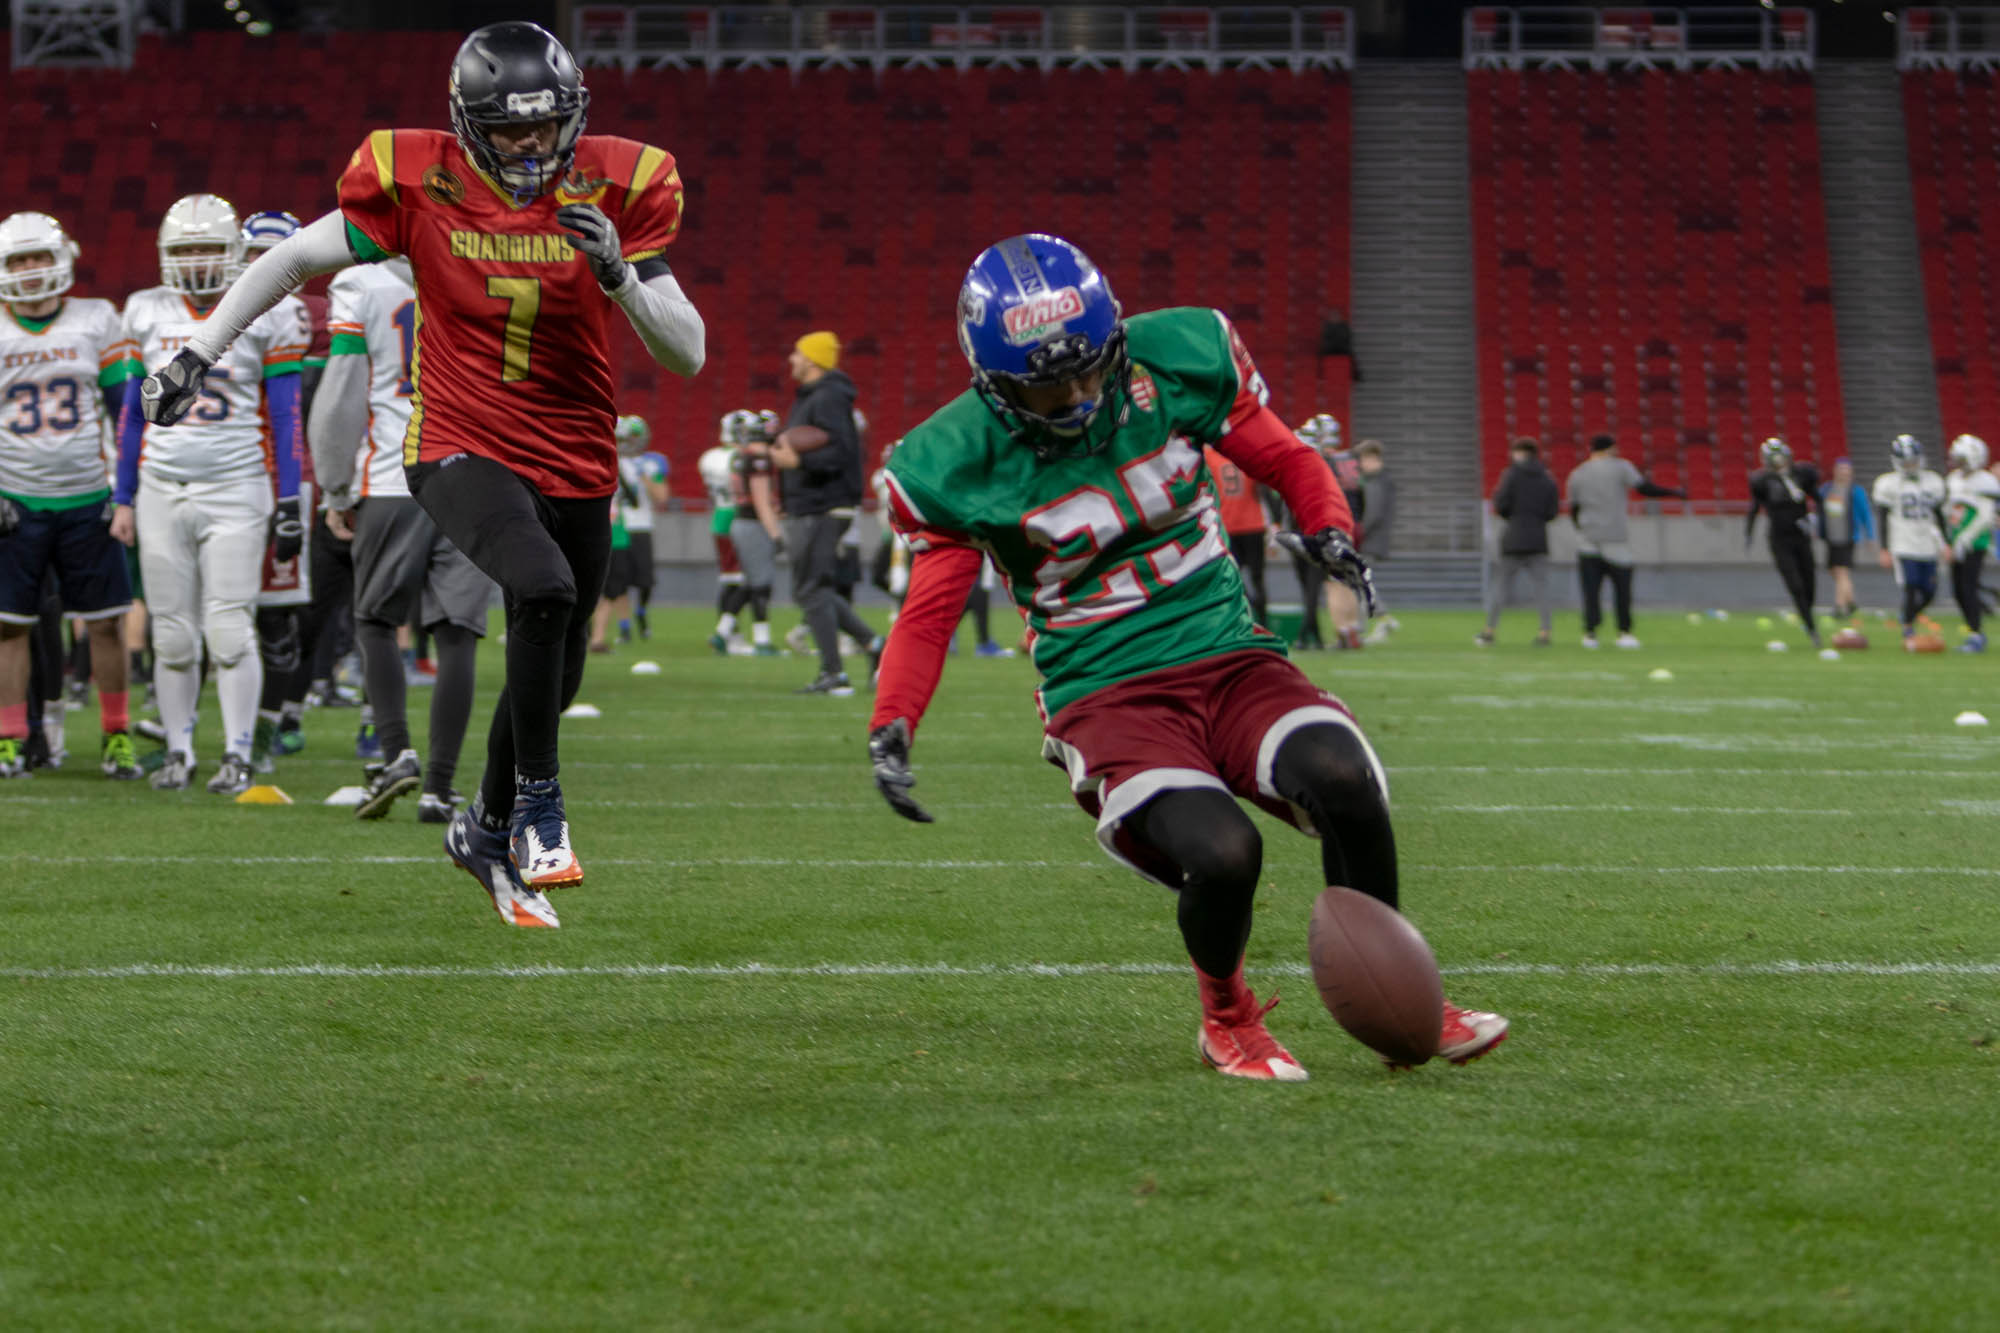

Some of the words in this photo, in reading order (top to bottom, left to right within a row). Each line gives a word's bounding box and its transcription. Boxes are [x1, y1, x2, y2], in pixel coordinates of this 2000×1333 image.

[450, 230, 576, 263] GUARDIANS
[4, 347, 79, 369] TITANS
[486, 274, 541, 383] 7
[5, 375, 82, 436] 33
[1019, 430, 1227, 629] 25
